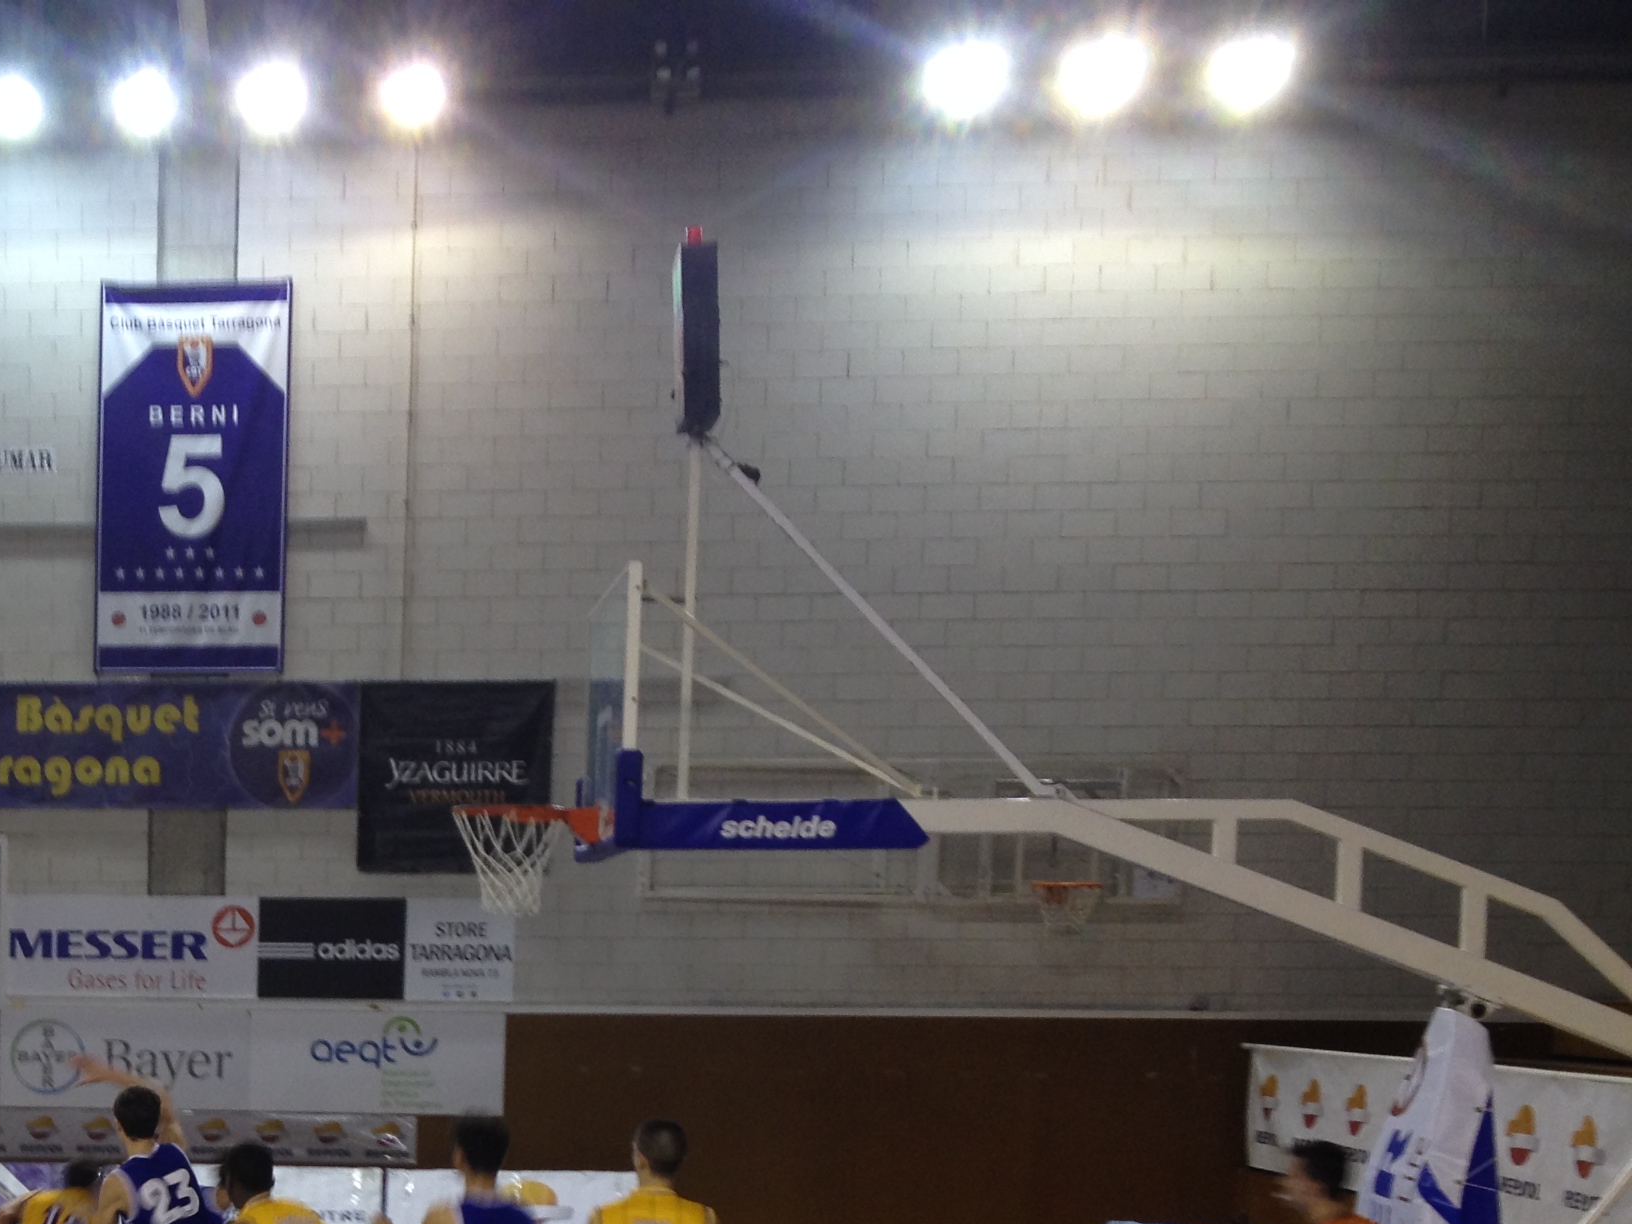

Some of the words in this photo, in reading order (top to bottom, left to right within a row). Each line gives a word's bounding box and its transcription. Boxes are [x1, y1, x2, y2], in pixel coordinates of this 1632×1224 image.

[148, 403, 238, 428] BERNI
[158, 433, 225, 540] 5
[198, 602, 240, 621] 2011
[719, 814, 837, 842] schelde
[434, 920, 488, 939] STORE
[8, 928, 207, 961] MESSER
[317, 938, 400, 961] adidas
[409, 942, 514, 962] TARRAGONA
[67, 966, 128, 992] Gases
[133, 967, 161, 991] for
[169, 967, 207, 992] Life
[101, 1037, 234, 1088] Bayer
